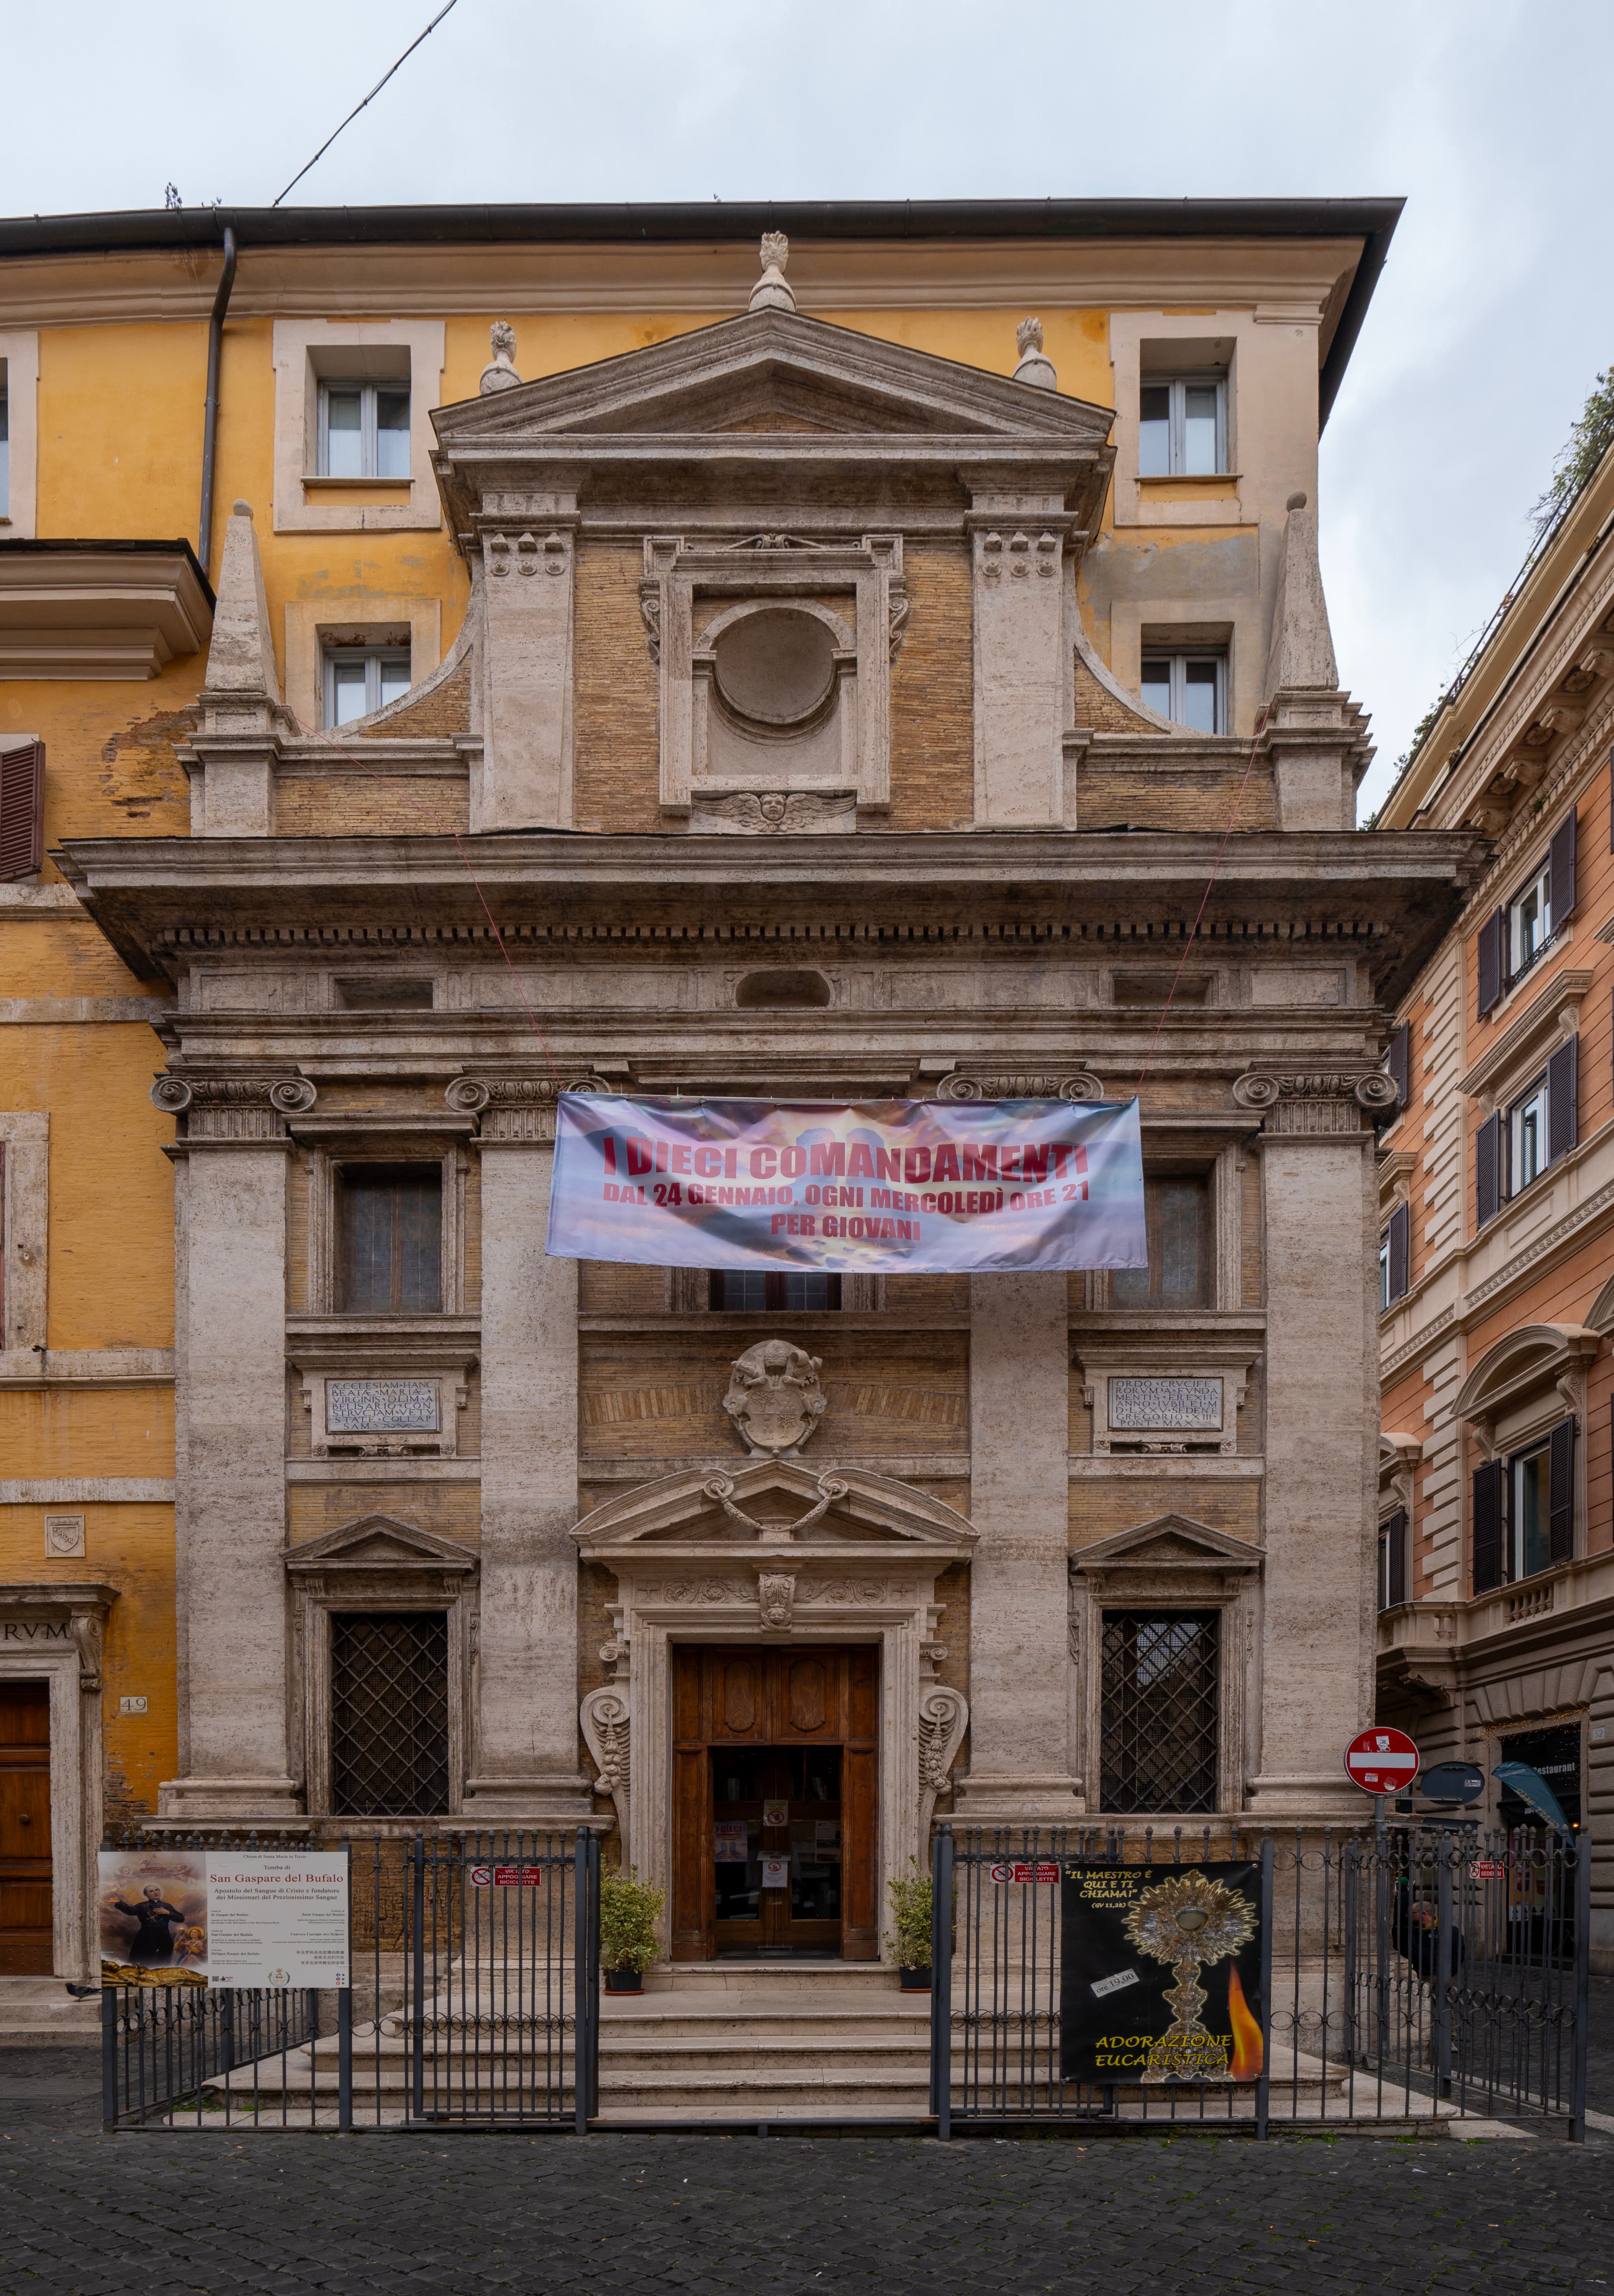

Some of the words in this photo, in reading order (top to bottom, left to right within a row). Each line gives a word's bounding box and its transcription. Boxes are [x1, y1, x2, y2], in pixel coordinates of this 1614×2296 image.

[603, 1137, 616, 1176] I
[626, 1136, 737, 1179] DIECI
[750, 1142, 1088, 1184] COMANDAMENTI
[603, 1183, 648, 1206] DAL
[654, 1182, 682, 1207] 24
[688, 1183, 798, 1207] GENNAIO,
[805, 1184, 864, 1208] OGNI
[871, 1187, 1003, 1215] MERCOLEDÌ
[1010, 1188, 1057, 1212] ORE
[1063, 1180, 1089, 1201] 21
[771, 1213, 815, 1237] PER
[822, 1215, 920, 1241] GIOVANI
[5, 1623, 69, 1640] RVM
[121, 1697, 146, 1711] 49
[1594, 1729, 1603, 1738] 52
[235, 1874, 281, 1884] Gaspare
[285, 1874, 301, 1882] del
[306, 1874, 343, 1882] Bufalo
[1086, 1871, 1142, 1879] MAESTRO
[1145, 1870, 1153, 1878] È
[1083, 1881, 1108, 1890] QUI
[1097, 1985, 1108, 1993] ore
[1109, 1973, 1134, 1988] 19,00
[1095, 2035, 1232, 2048] ADORAZIONE
[1095, 2053, 1229, 2066] EUCARISTICA
